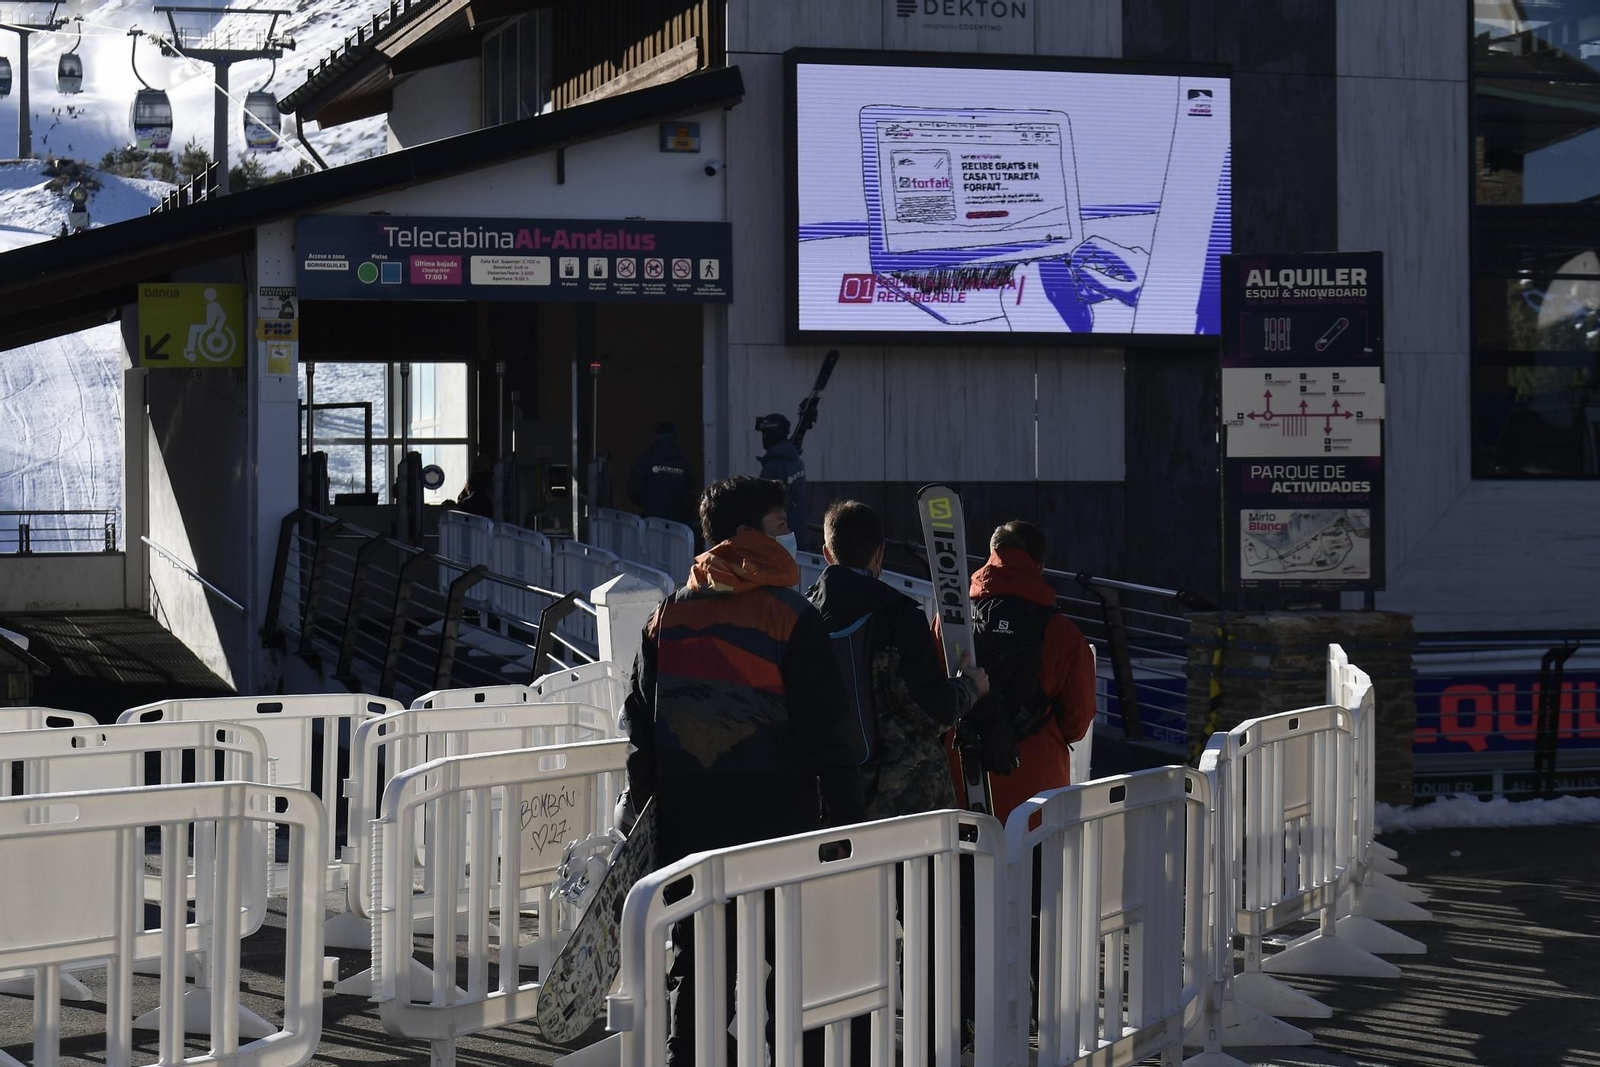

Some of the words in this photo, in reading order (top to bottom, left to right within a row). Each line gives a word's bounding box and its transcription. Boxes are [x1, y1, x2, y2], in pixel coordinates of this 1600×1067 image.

[924, 0, 1026, 18] DEKTON
[959, 23, 1002, 32] COSENTINO
[962, 162, 993, 171] RECIBE
[995, 162, 1026, 171] GRATIS
[1028, 162, 1039, 170] EN
[963, 172, 988, 181] CASA
[989, 172, 1001, 181] TU
[1003, 172, 1040, 181] TARJETA
[913, 177, 951, 189] forfait
[415, 259, 435, 268] Última
[436, 261, 458, 271] bajada
[425, 274, 443, 282] 17:00
[1246, 268, 1368, 289] ALQUILER
[844, 276, 875, 301] 01
[1245, 287, 1280, 299] ESQUÍ
[1282, 289, 1291, 298] &
[1293, 288, 1368, 299] SNOWBOARD
[877, 291, 966, 303] RECARGABLE
[1250, 465, 1320, 481] PARQUE
[1323, 464, 1347, 479] DE
[1271, 480, 1372, 493] ACTIVIDADES
[1249, 512, 1276, 522] Mirlo
[520, 785, 575, 831] BOMBÓN
